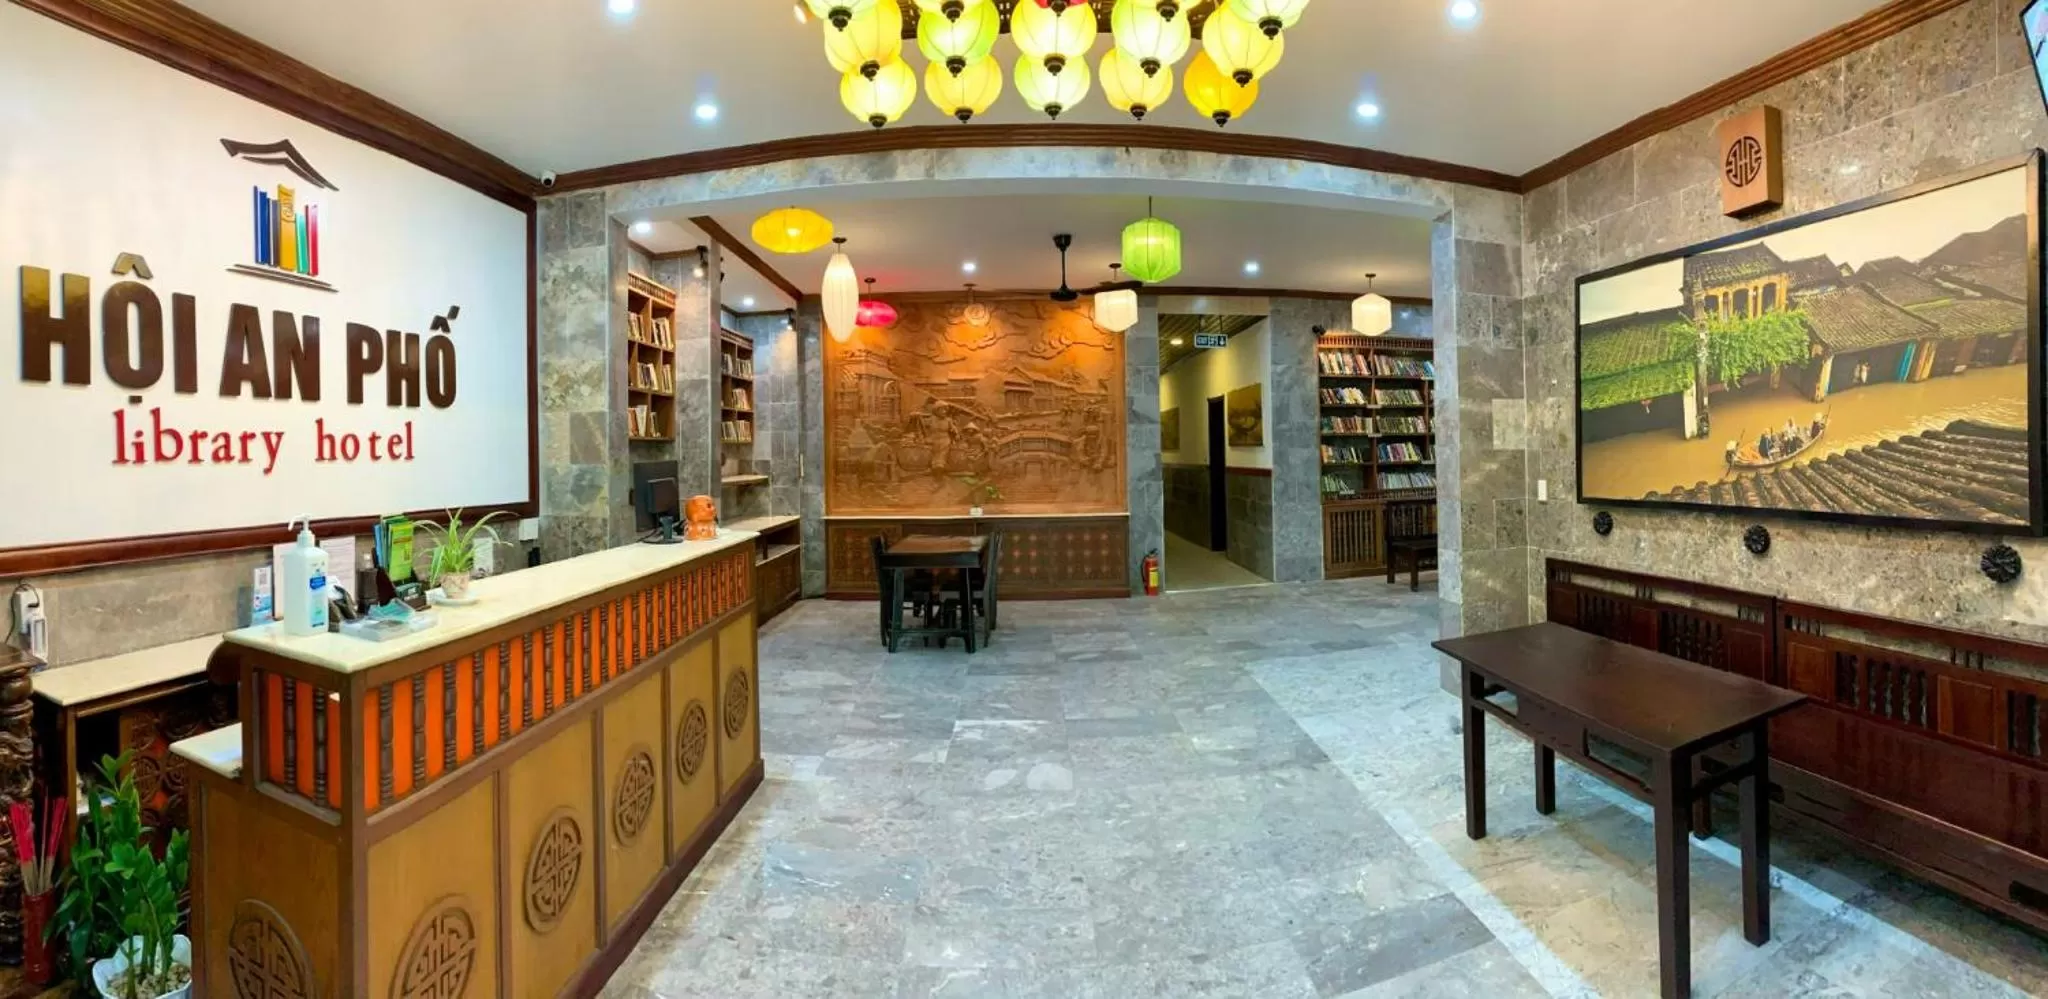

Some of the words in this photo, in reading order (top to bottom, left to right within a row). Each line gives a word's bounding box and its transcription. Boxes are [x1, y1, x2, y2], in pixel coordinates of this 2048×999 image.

[20, 252, 197, 404] HỘI
[220, 303, 321, 402] AN
[347, 305, 460, 409] PHỐ
[113, 408, 285, 474] library
[316, 418, 415, 463] hotel
